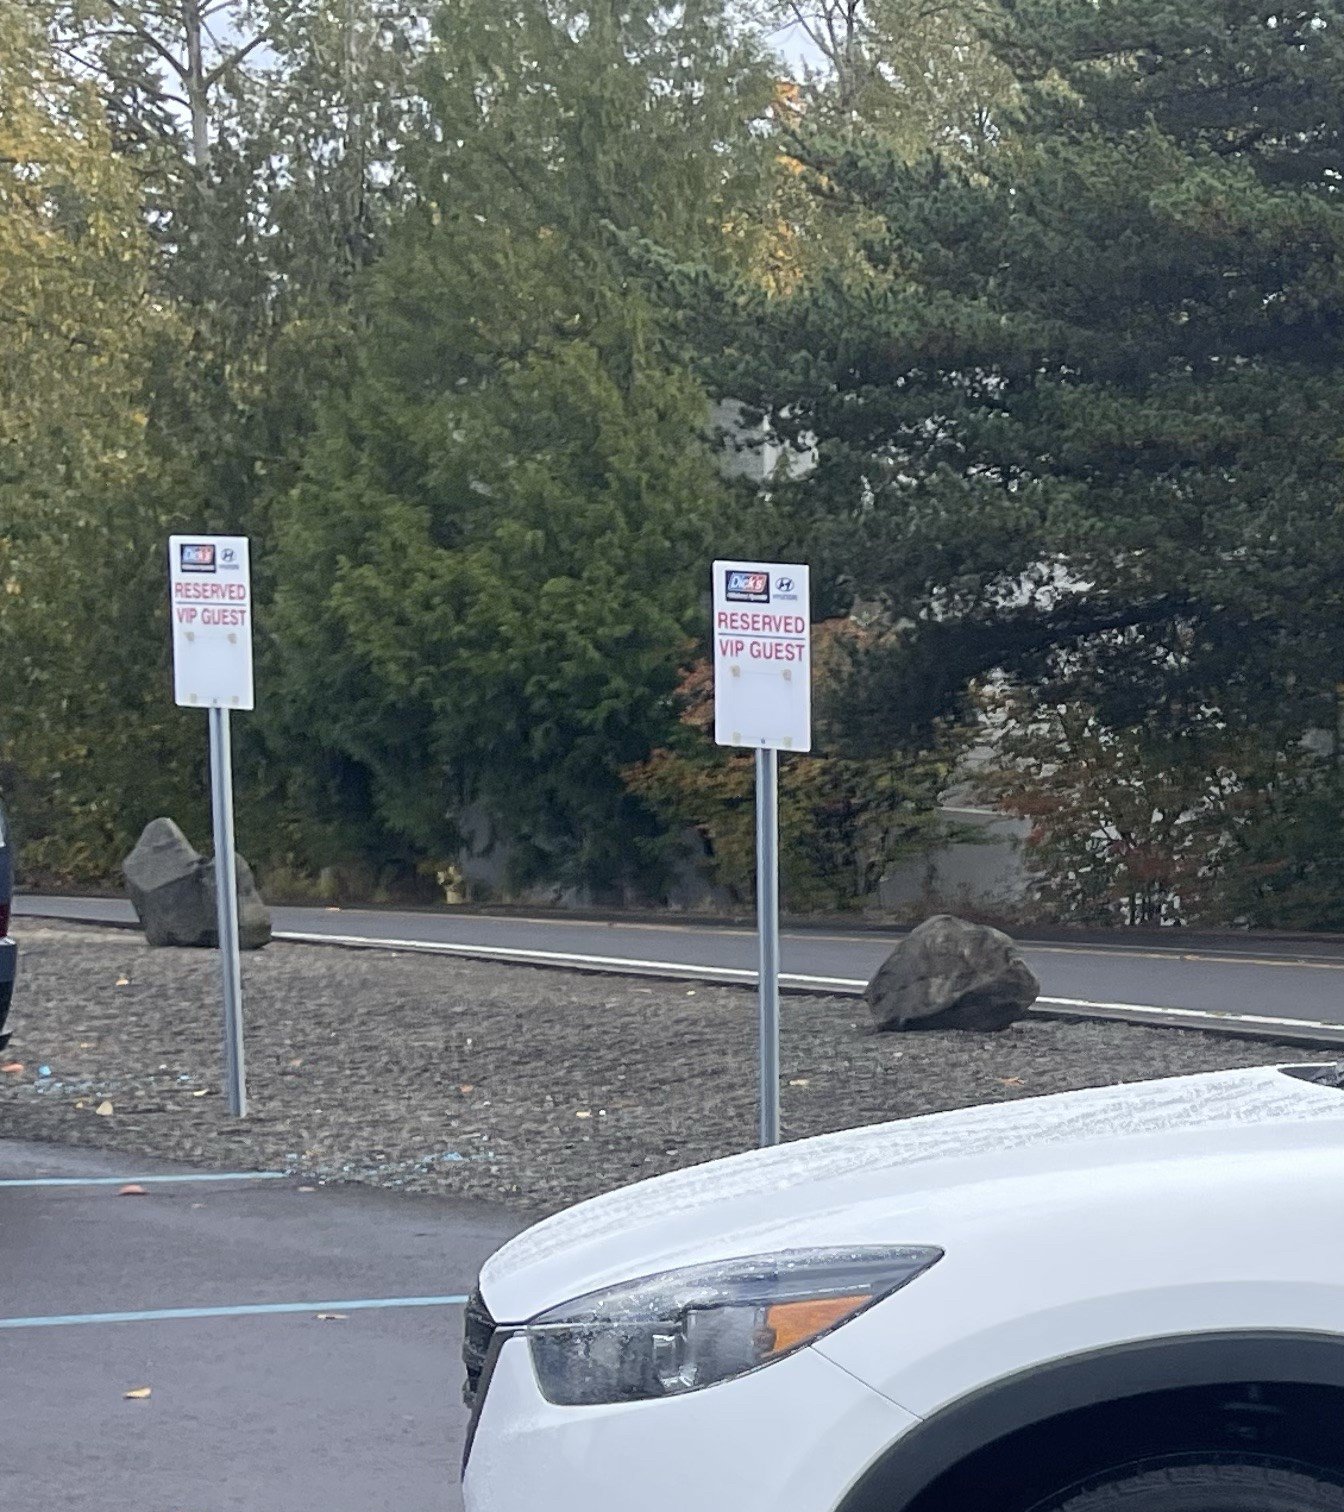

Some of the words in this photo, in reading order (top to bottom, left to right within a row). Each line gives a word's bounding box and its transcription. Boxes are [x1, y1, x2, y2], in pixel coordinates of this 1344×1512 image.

[174, 582, 246, 600] RESERVED
[176, 607, 198, 624] VIP
[201, 607, 247, 626] GUEST
[717, 611, 805, 634] RESERVED
[719, 638, 745, 658] VIP
[750, 640, 806, 662] GUEST
